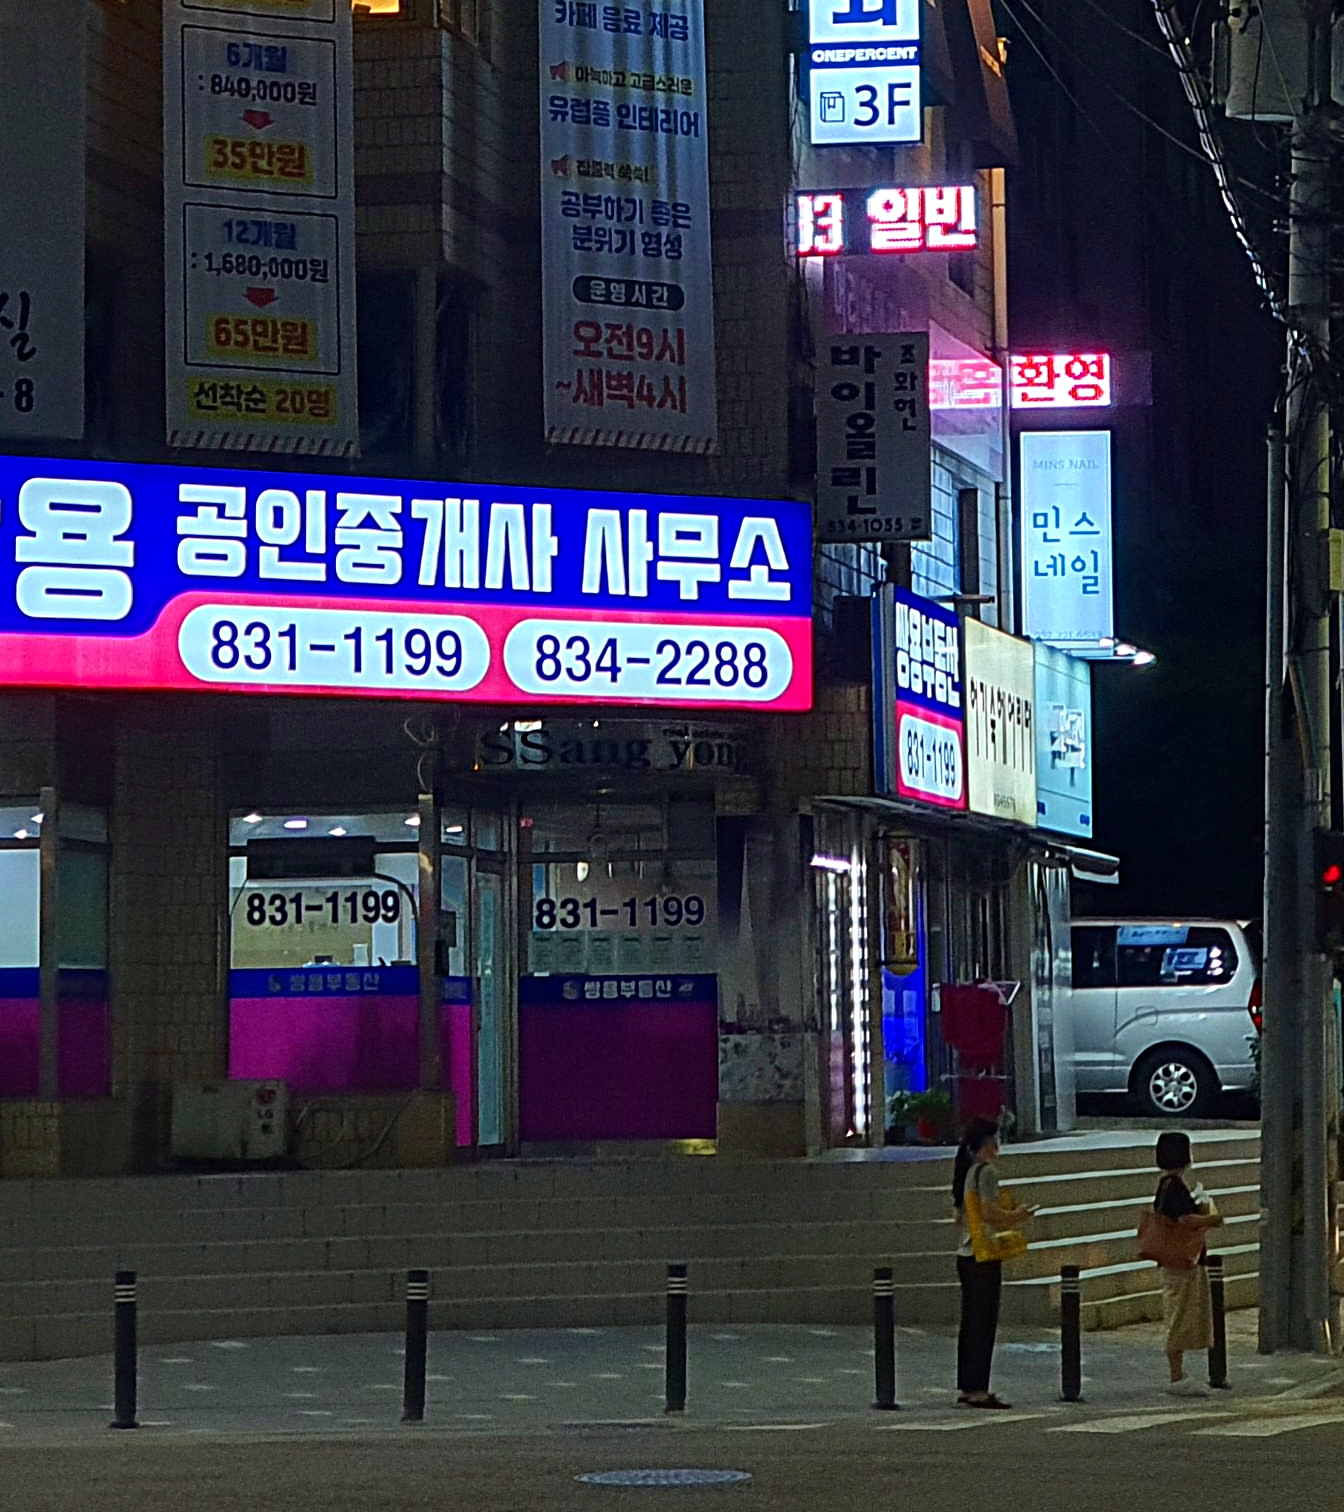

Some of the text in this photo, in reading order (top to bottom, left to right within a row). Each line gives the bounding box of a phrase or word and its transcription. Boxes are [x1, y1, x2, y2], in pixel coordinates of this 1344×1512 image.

[555, 0, 689, 42] 카페 음료 제공
[227, 43, 287, 72] 6개월
[811, 46, 918, 64] ONEPERCENT
[550, 95, 699, 138] 유럽풍 인테리어
[853, 82, 912, 127] 3F
[213, 139, 306, 180] 35만원
[561, 191, 691, 230] 공부하기 좋은
[223, 219, 297, 250] 12개월
[573, 224, 683, 260] 분위기 형성
[590, 279, 669, 307] 운영시간
[214, 317, 308, 355] 65만원
[573, 320, 685, 366] 오전9시
[1011, 354, 1105, 402] 환영
[195, 381, 330, 417] 선착순 20명
[831, 345, 882, 515] 바이올린
[1033, 459, 1100, 470] MINS NAIL
[176, 483, 791, 601] 공인중개사 사무소
[1032, 505, 1101, 543] 민스
[1034, 549, 1100, 595] 네일
[211, 619, 463, 678] 831-1199
[535, 633, 768, 688] 834-2288
[907, 729, 956, 788] 831-1199
[246, 889, 401, 927] 831-1199
[535, 895, 705, 929] 831-1199
[584, 979, 672, 999] 쌍용부동산
